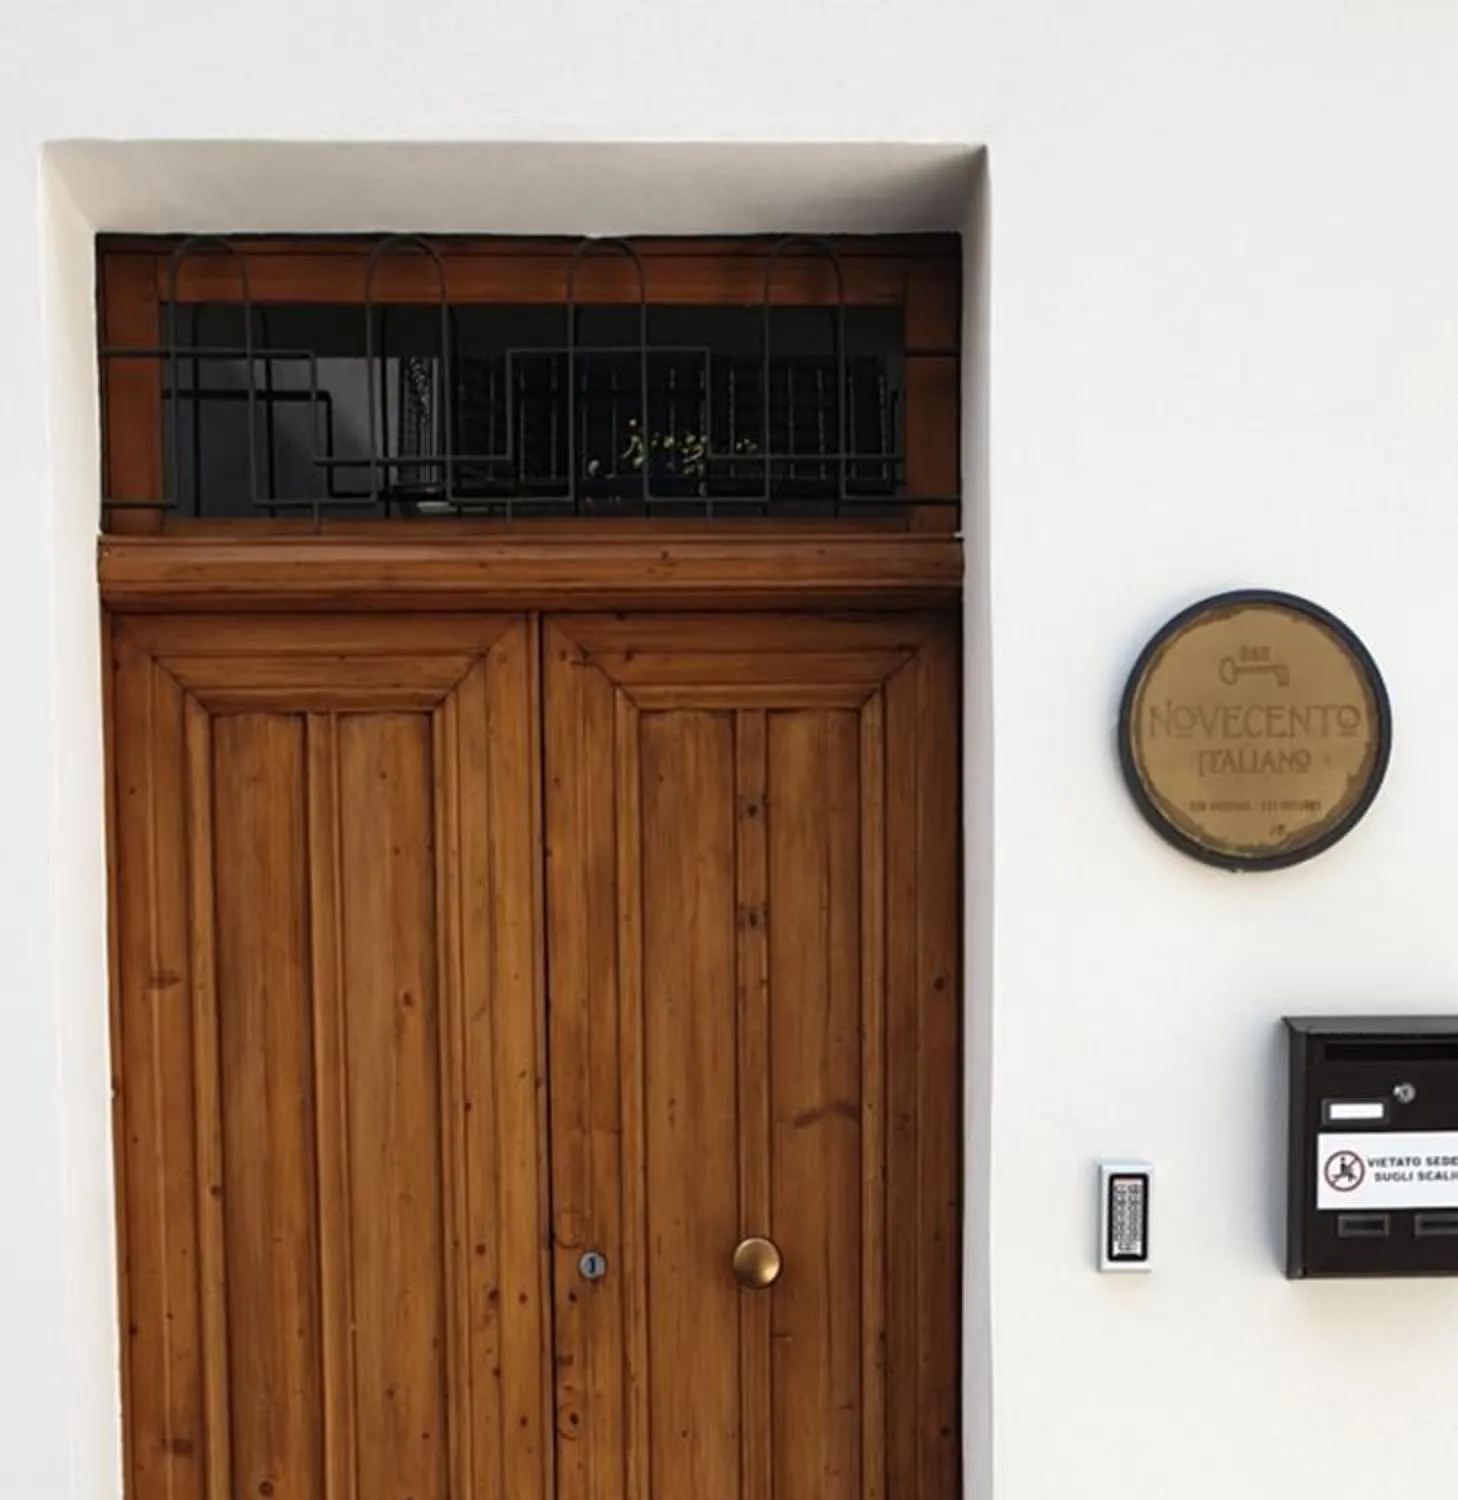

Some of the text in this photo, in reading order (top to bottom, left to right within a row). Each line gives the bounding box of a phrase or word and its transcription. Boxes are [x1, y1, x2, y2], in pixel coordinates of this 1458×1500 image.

[1149, 700, 1362, 738] NOVECENTO
[1199, 747, 1312, 777] ITALIANO
[1367, 1156, 1422, 1169] VIETATO
[1374, 1171, 1413, 1183] SUGLI
